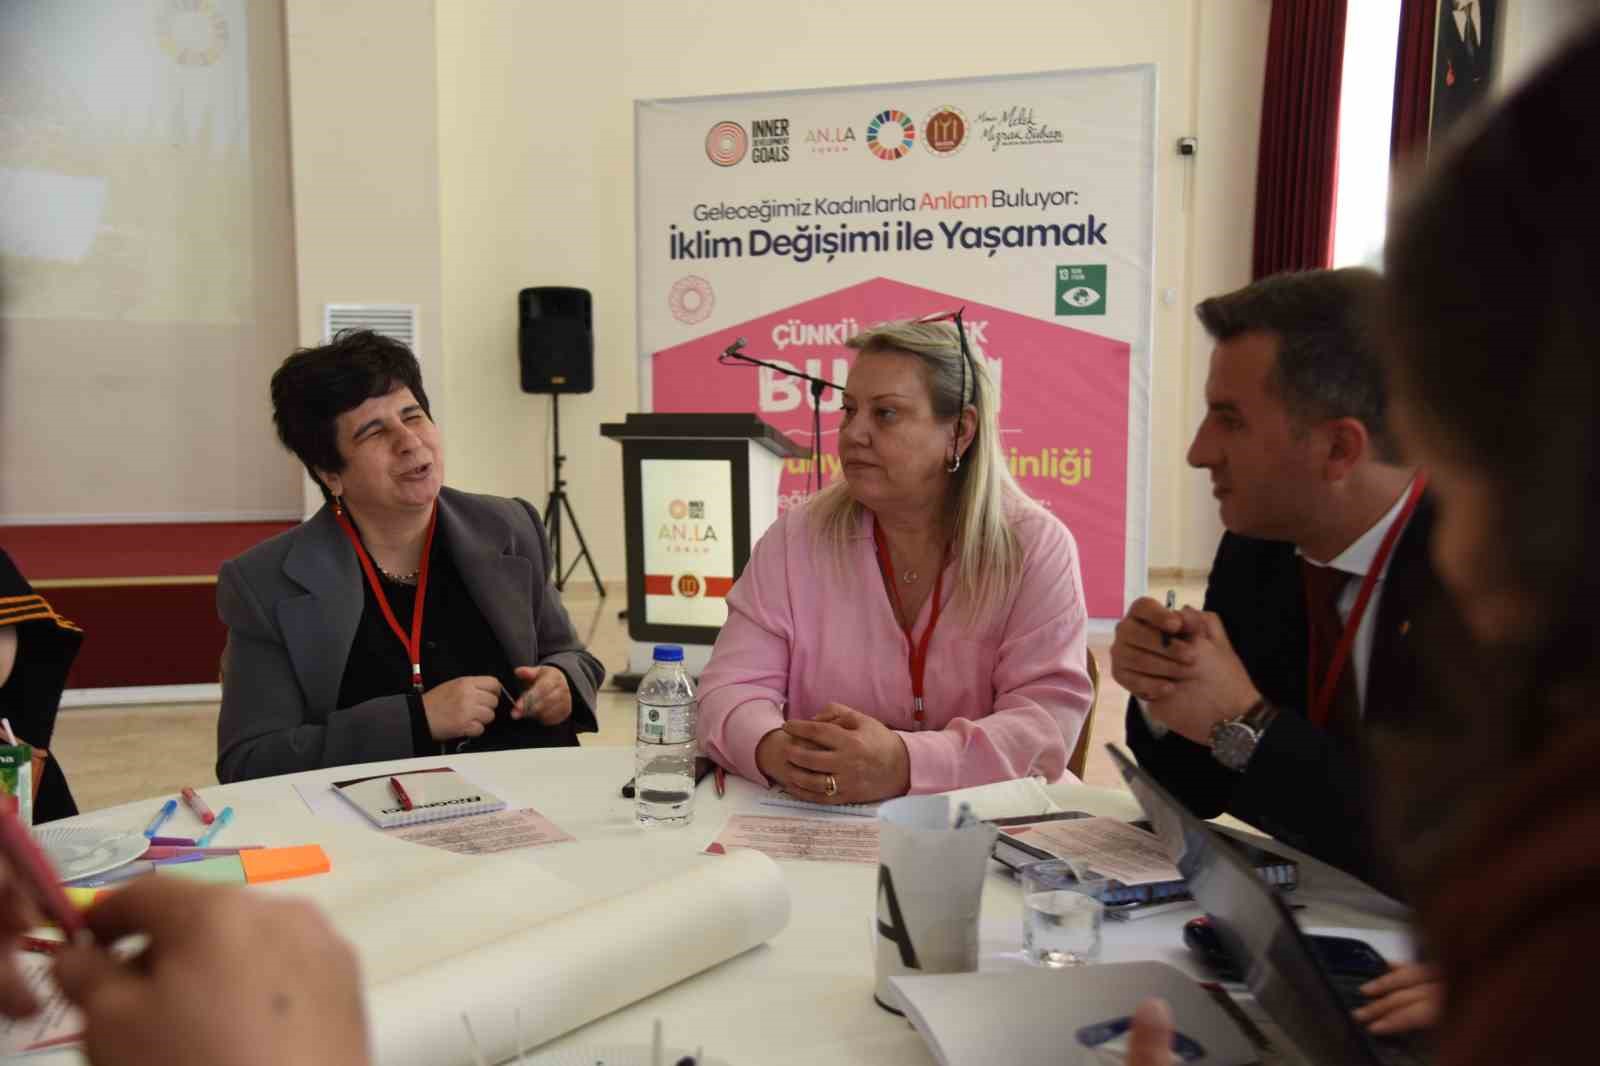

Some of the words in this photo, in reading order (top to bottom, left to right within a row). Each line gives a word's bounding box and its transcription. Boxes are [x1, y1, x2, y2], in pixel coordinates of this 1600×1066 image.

[752, 118, 790, 138] INNER
[752, 145, 790, 163] GOALS
[693, 198, 811, 223] Geleceğimiz
[815, 193, 916, 216] Kadınlarla
[919, 191, 989, 210] Anlam
[991, 188, 1079, 210] Buluyor:
[670, 224, 743, 260] İklim
[749, 221, 890, 263] Değişimi
[896, 220, 934, 251] ile
[938, 214, 1108, 258] Yaşamak
[771, 318, 859, 350] ÇÜNKÜ
[1010, 448, 1091, 486] inliği
